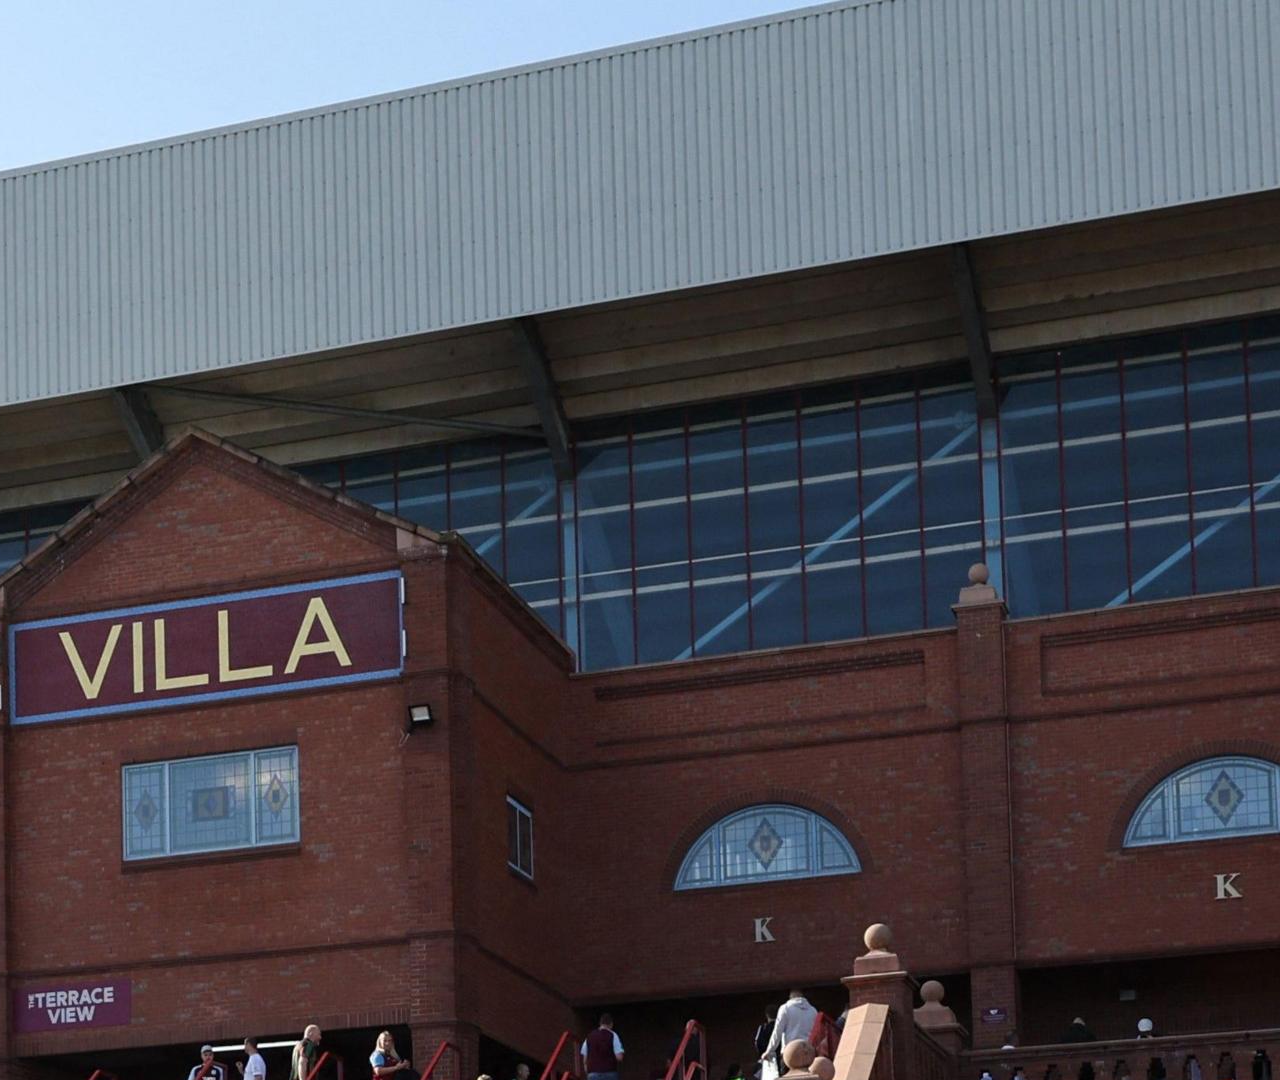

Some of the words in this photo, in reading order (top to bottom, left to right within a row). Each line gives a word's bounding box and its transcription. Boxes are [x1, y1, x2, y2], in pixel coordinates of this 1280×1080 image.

[58, 596, 353, 700] VILLA
[1213, 872, 1244, 900] K
[753, 917, 777, 943] K
[34, 986, 115, 1009] TERRACE
[47, 1005, 96, 1024] VIEW
